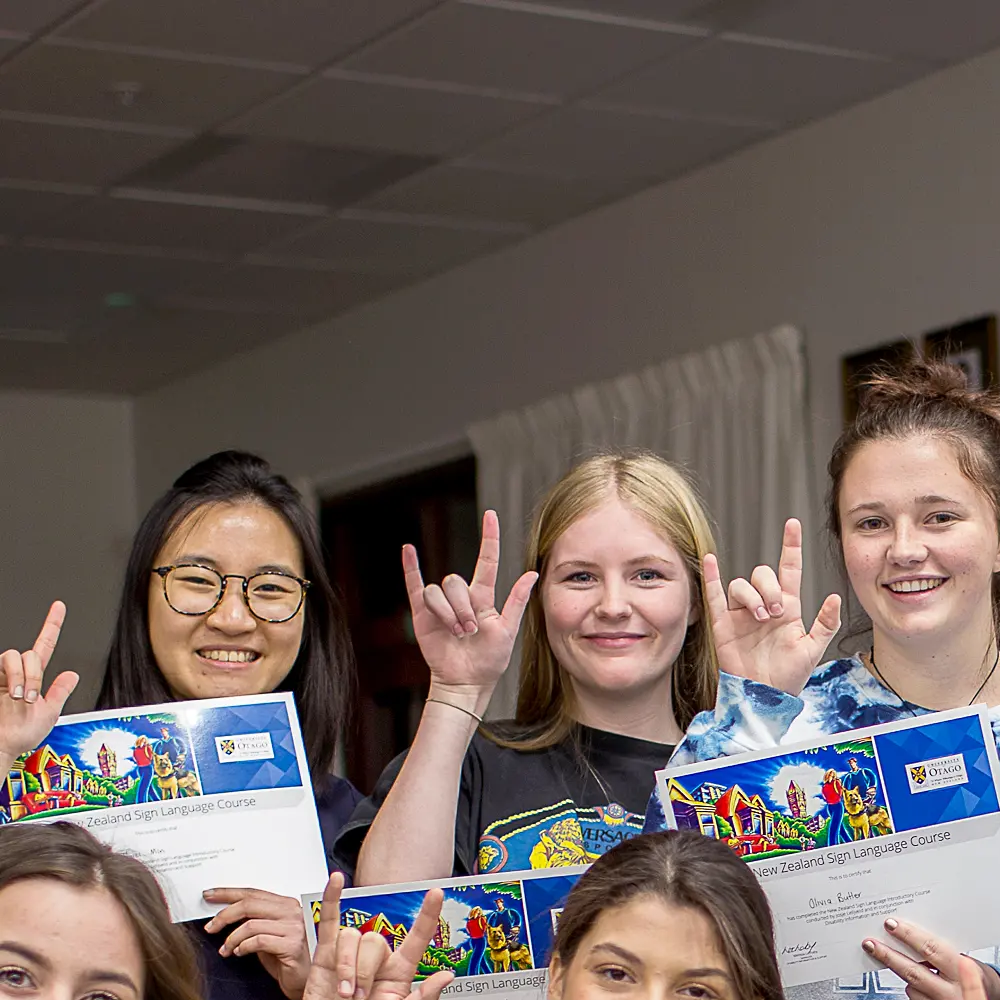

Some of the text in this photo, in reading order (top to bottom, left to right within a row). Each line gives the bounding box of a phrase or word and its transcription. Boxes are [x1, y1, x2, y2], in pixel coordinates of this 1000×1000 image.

[929, 764, 961, 777] OTAGO
[87, 812, 132, 828] Zealand
[134, 809, 159, 822] Sign
[161, 802, 215, 817] Language
[217, 796, 256, 810] Course
[582, 828, 634, 843] VERSAC
[583, 841, 612, 851] SPO
[753, 831, 951, 878] New Zealand Sign Language Course
[466, 980, 489, 994] Sign
[492, 974, 546, 989] Language
